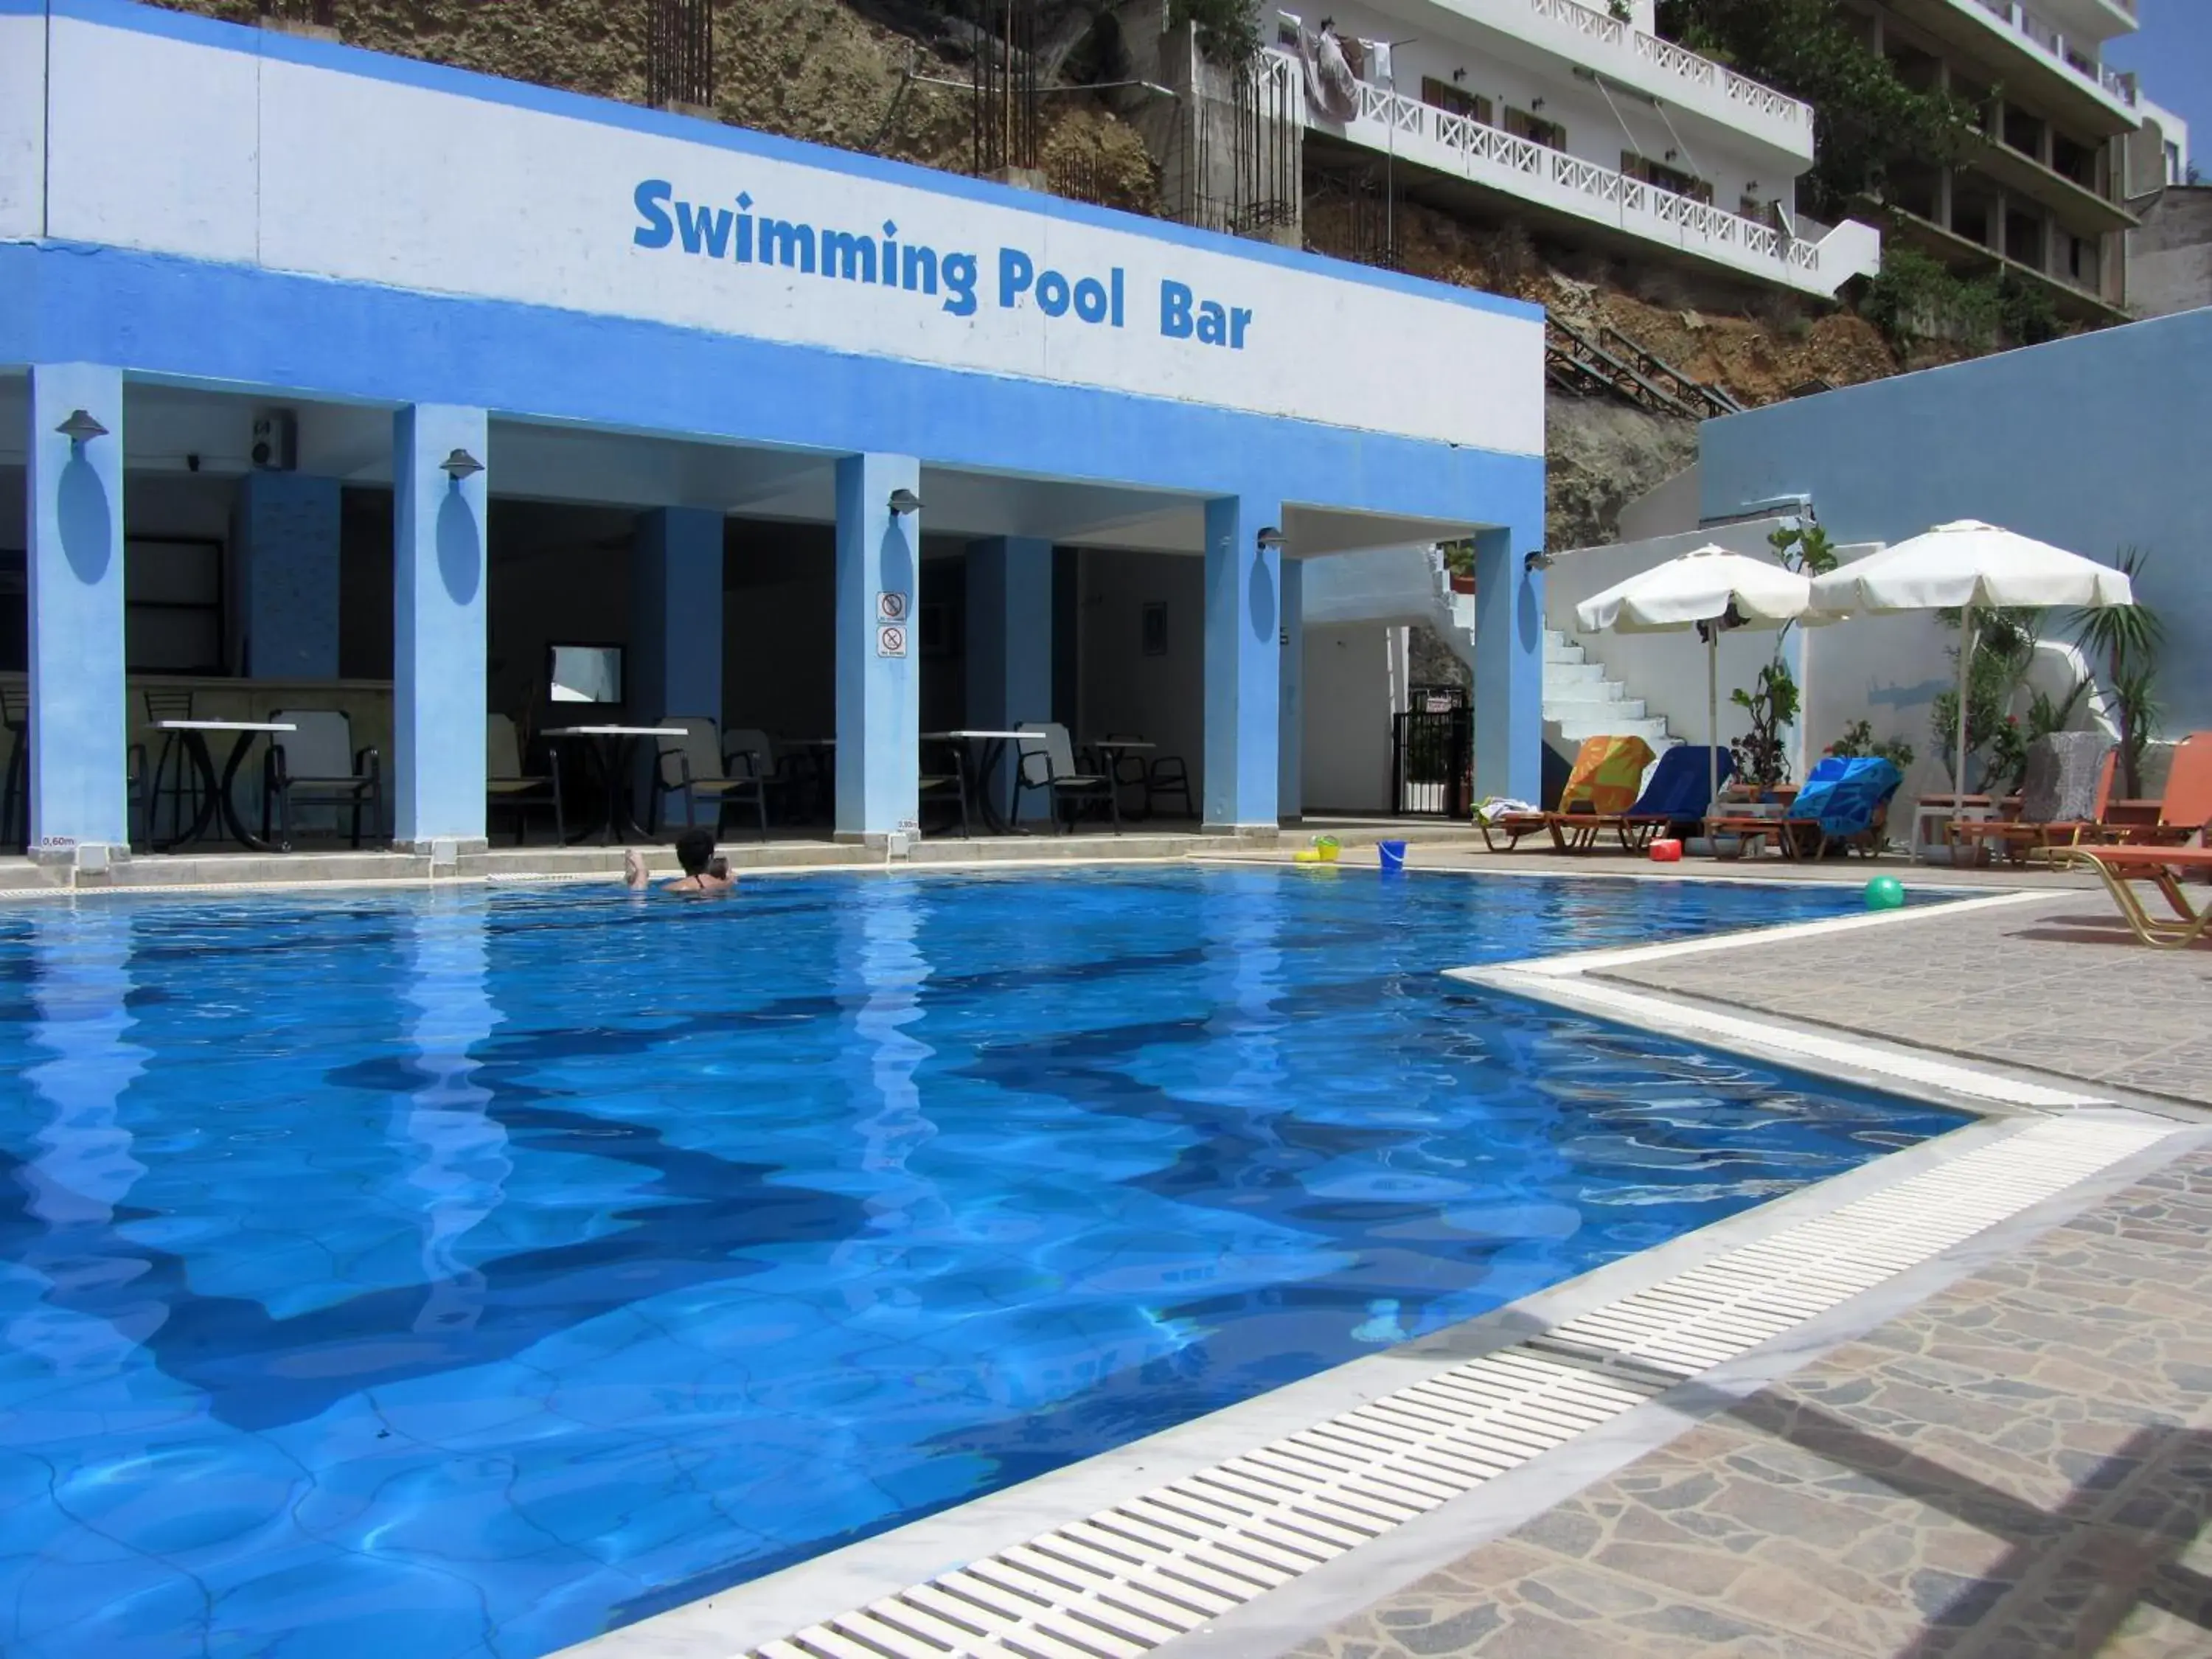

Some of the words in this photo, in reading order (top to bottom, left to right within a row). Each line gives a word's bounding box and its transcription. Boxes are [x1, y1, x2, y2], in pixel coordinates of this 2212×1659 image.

[633, 179, 977, 316] Swimming
[999, 247, 1124, 327] Pool
[1161, 279, 1252, 349] Bar
[42, 837, 74, 847] 0,60m
